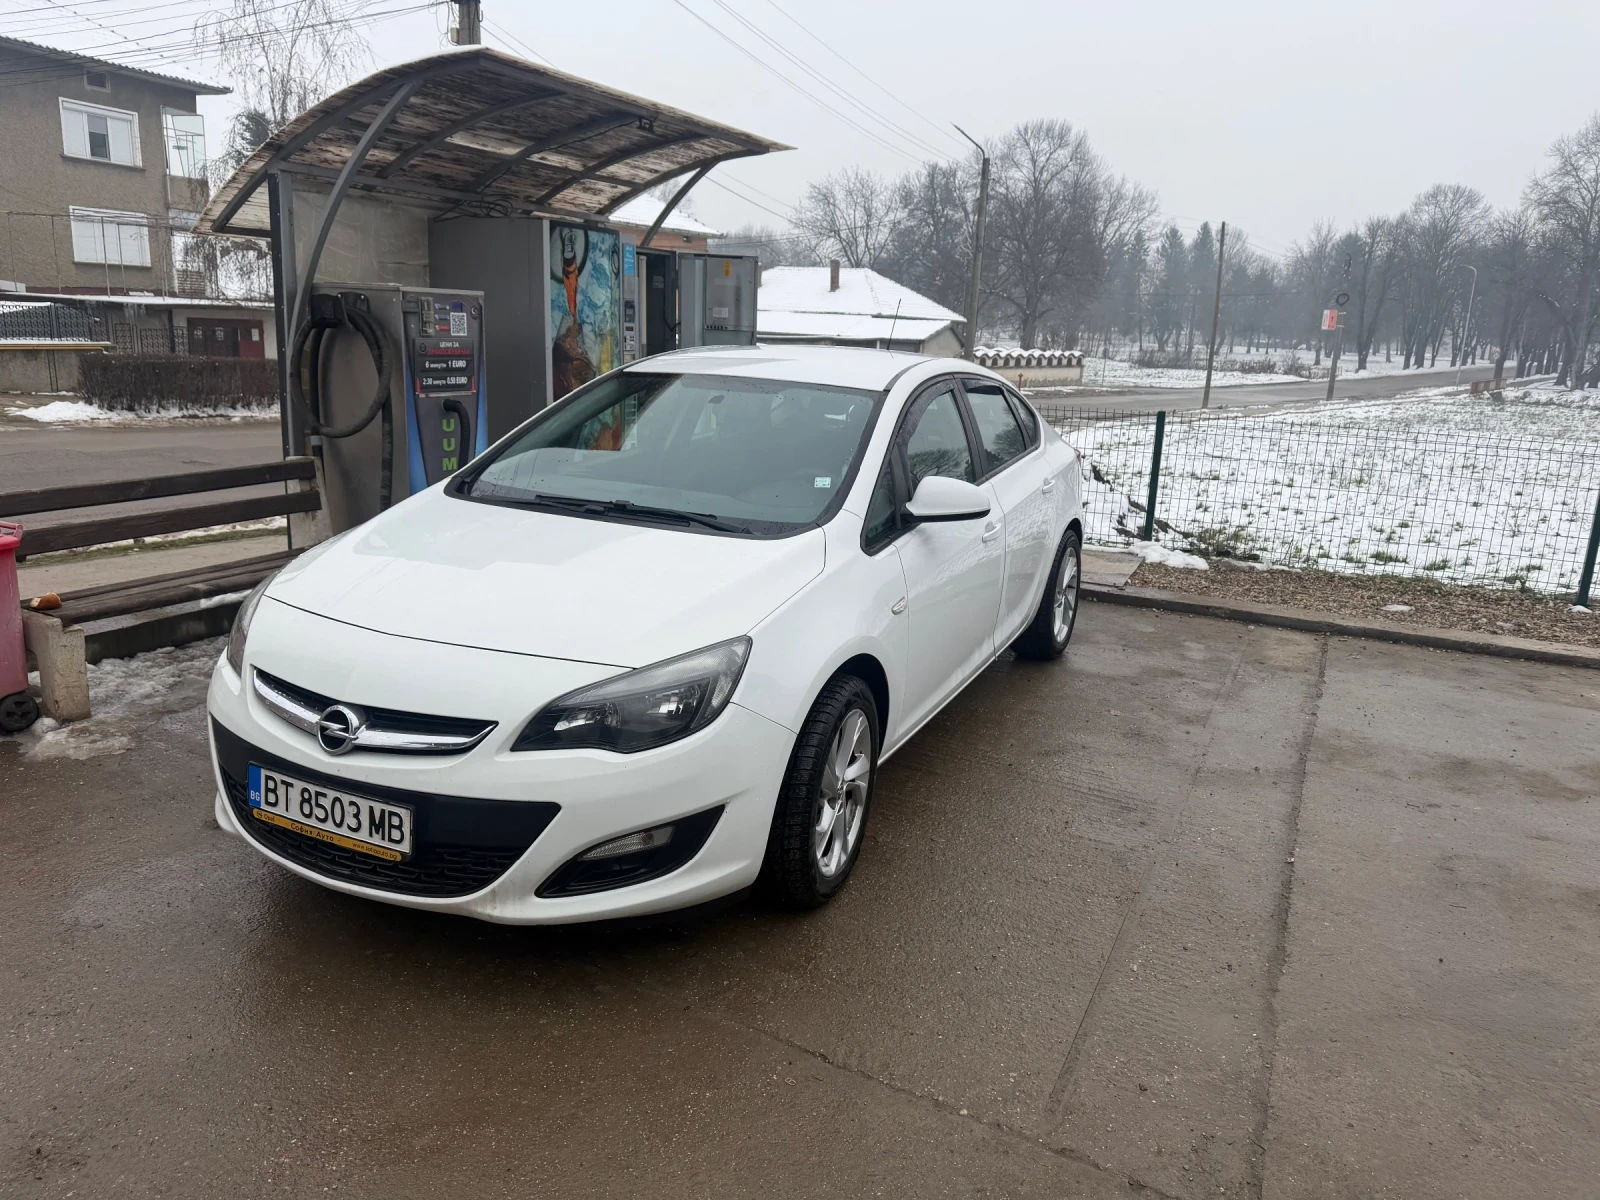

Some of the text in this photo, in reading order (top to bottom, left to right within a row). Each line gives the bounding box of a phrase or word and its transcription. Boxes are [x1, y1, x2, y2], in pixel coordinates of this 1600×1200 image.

[425, 360, 430, 368] 6
[448, 360, 452, 368] 1
[452, 360, 467, 368] EURO
[456, 376, 468, 384] EURO
[441, 405, 458, 471] UUM
[250, 789, 261, 802] BG
[264, 774, 405, 845] BT 8503 MB
[290, 822, 313, 835] София
[315, 830, 334, 842] Ауто
